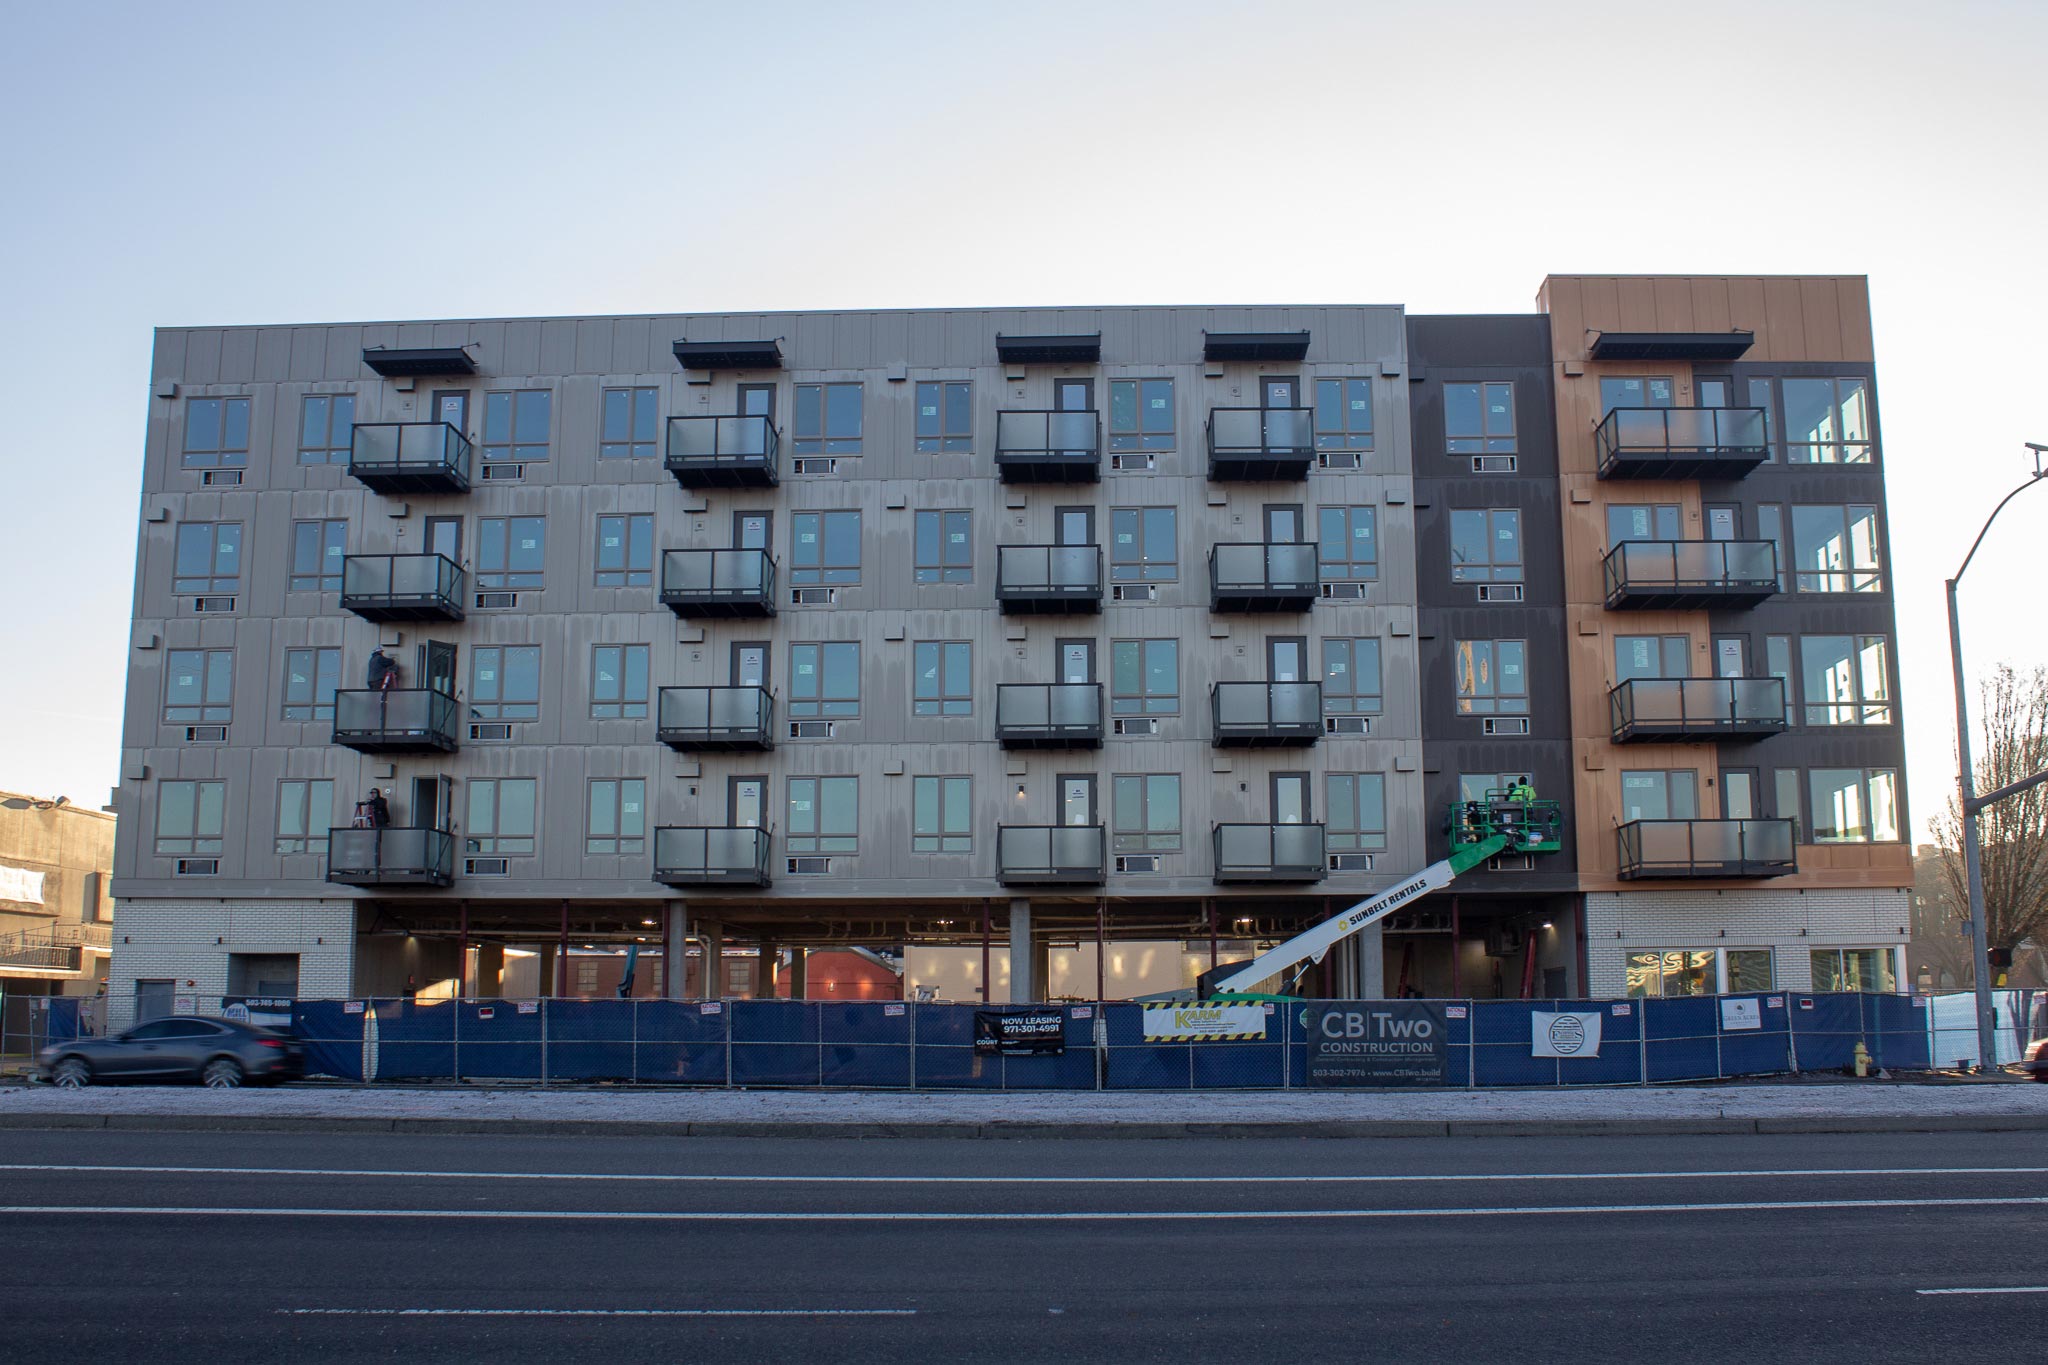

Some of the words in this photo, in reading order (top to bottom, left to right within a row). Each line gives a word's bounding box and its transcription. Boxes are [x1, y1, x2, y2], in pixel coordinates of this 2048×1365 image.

[1348, 899, 1388, 925] SUNBELT
[1388, 879, 1427, 905] RENTALS
[1001, 1017, 1024, 1025] NOW
[1025, 1016, 1062, 1024] LEASING
[1321, 1011, 1365, 1038] CB
[1003, 1024, 1060, 1033] 971-301-4991
[1320, 1042, 1433, 1053] CONSTRUCTION
[1312, 1069, 1366, 1077] 503-302-7976
